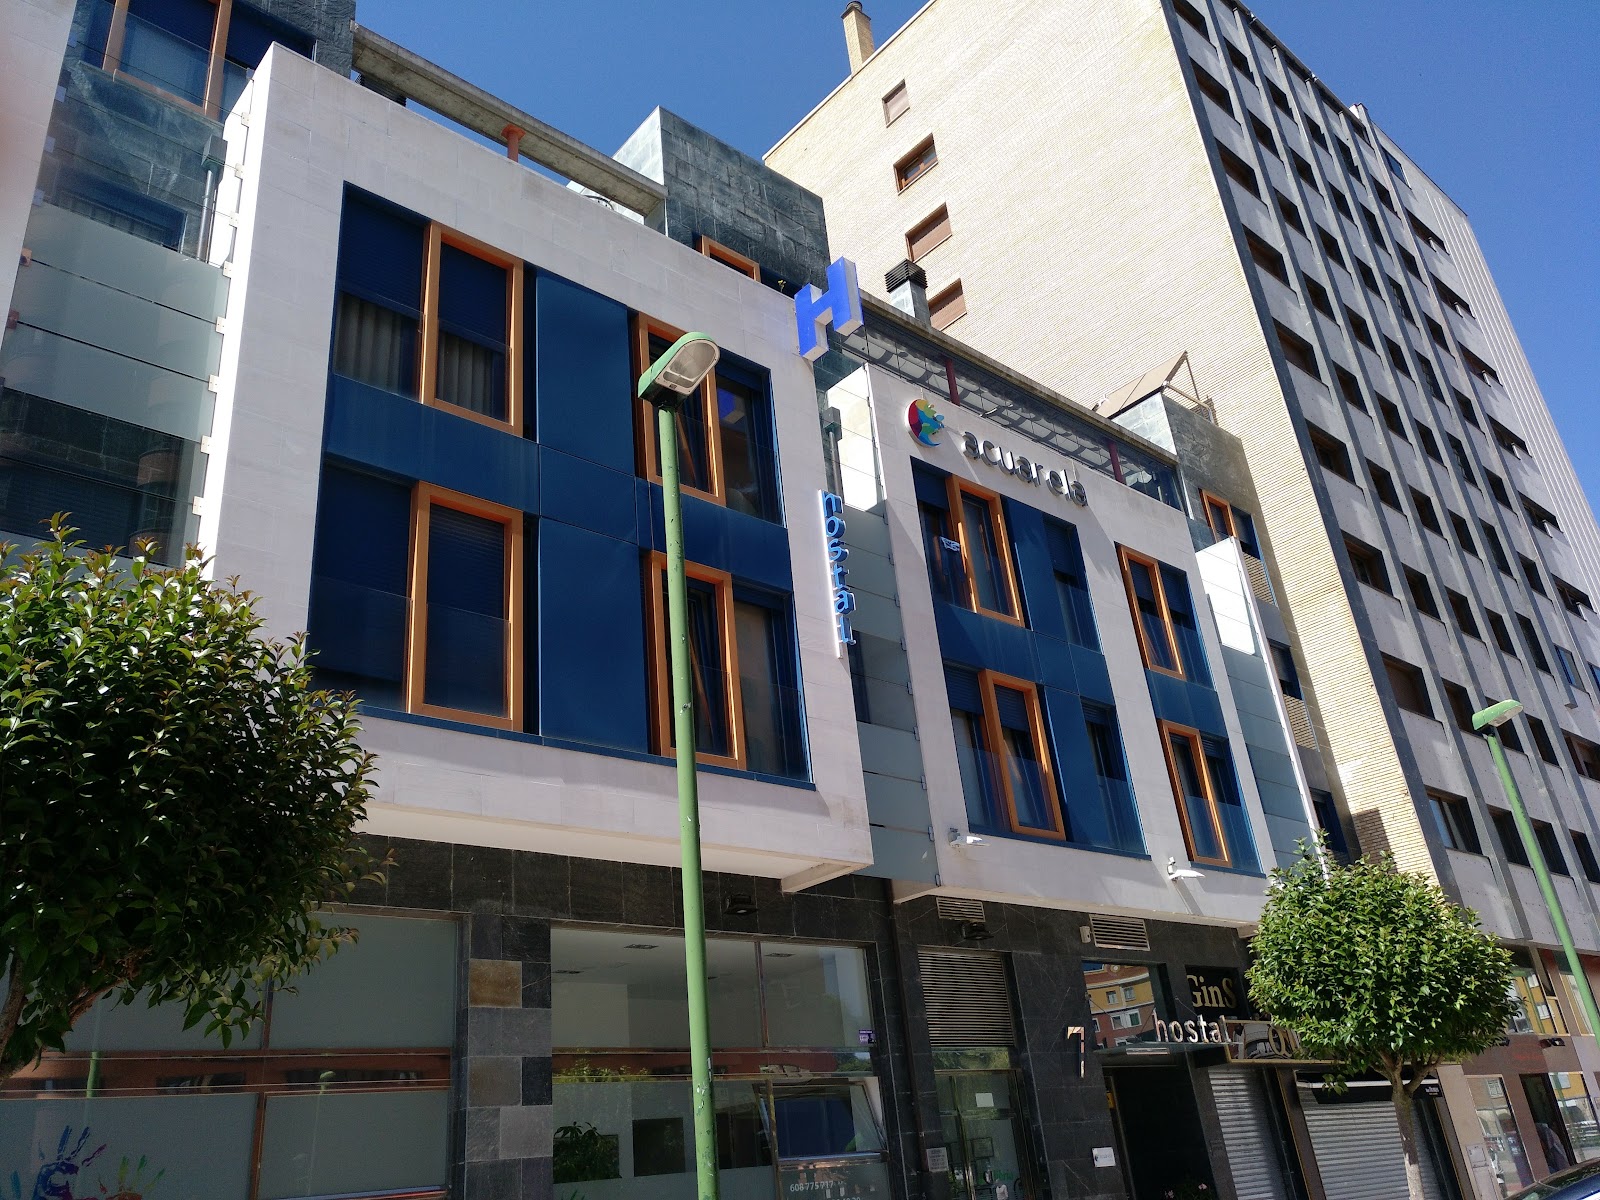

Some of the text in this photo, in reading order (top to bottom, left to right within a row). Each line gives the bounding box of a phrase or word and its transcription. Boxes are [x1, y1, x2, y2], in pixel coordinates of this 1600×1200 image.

[795, 257, 863, 361] H
[963, 431, 1088, 506] acuarela
[822, 491, 855, 645] hostal
[1066, 1026, 1085, 1077] 7
[1152, 1008, 1231, 1043] hostal
